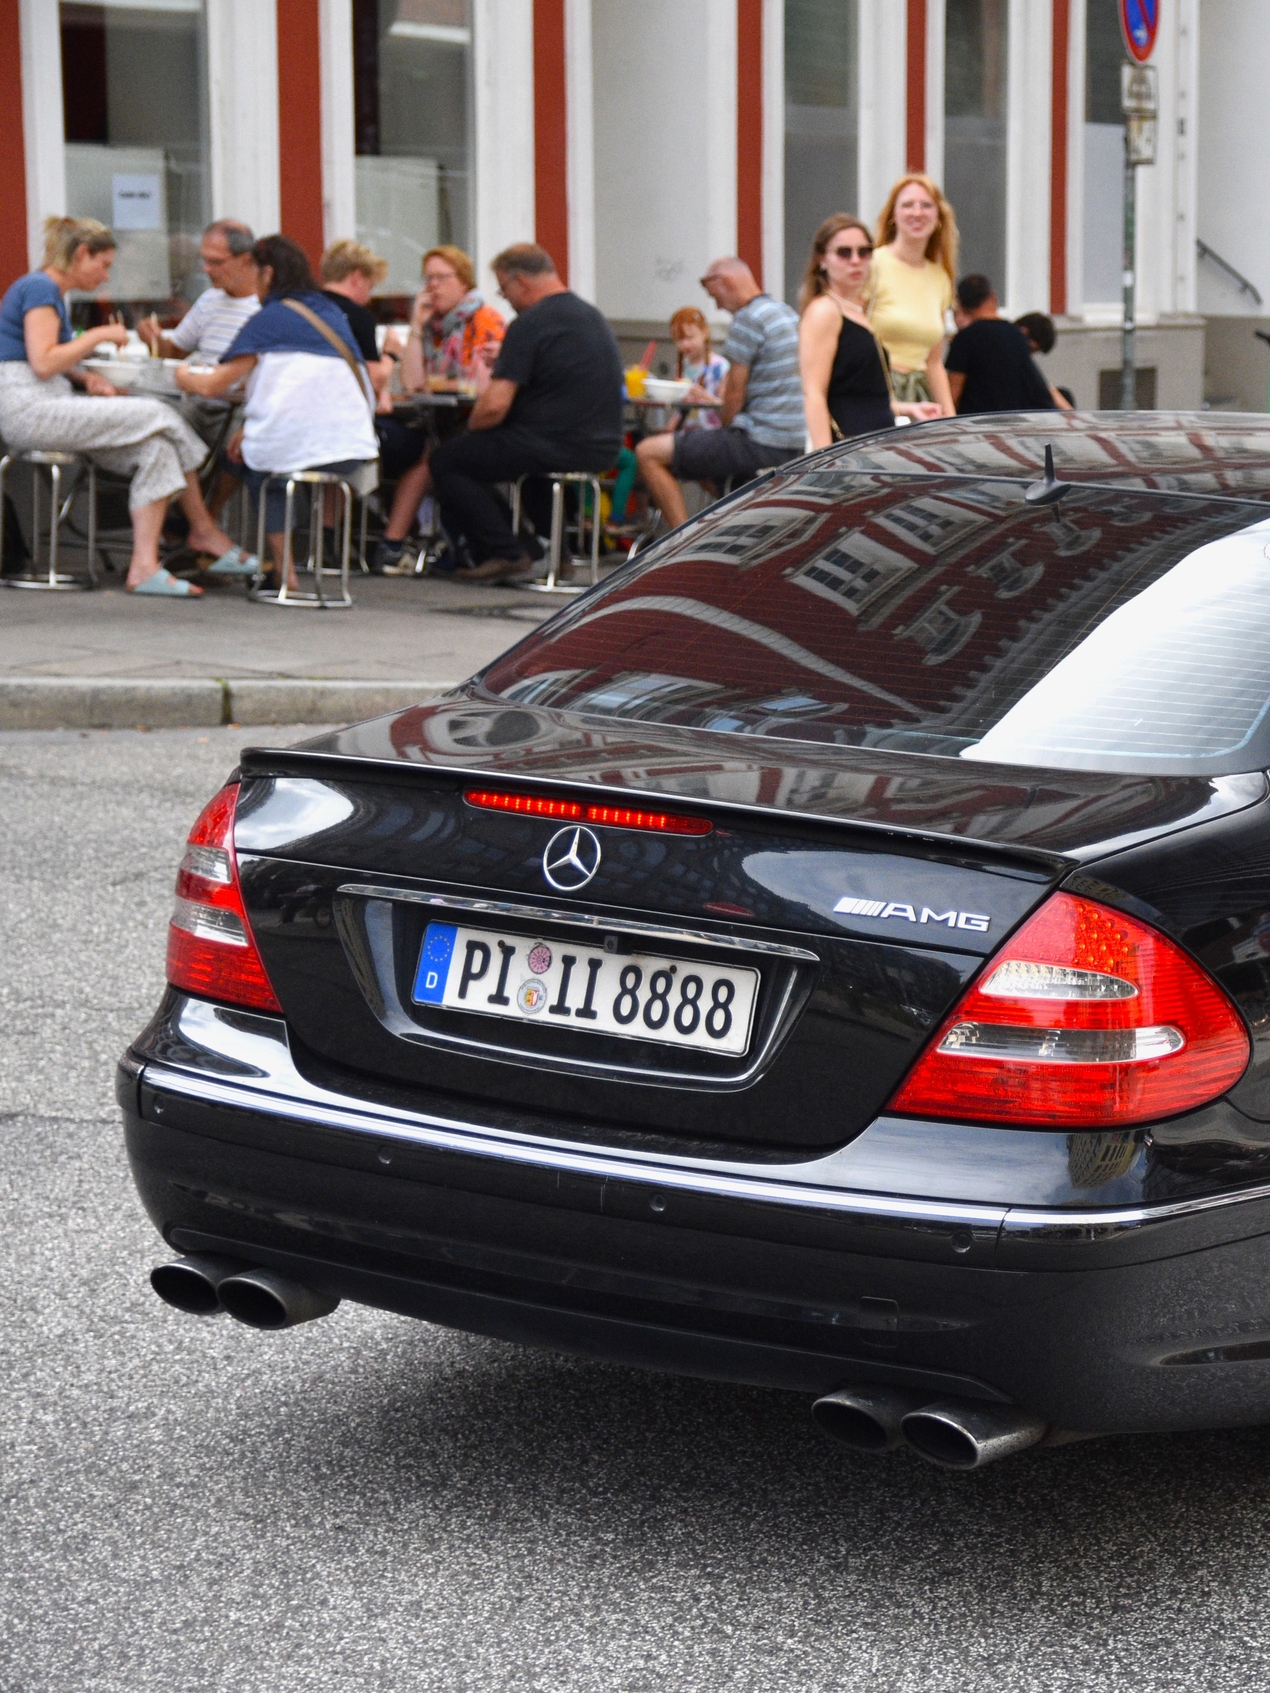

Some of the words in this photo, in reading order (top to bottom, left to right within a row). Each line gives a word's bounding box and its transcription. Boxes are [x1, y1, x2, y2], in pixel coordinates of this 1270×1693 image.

[880, 902, 991, 932] AMG
[425, 971, 439, 989] D
[458, 939, 516, 1006] PI
[548, 954, 603, 1020] II
[612, 965, 736, 1040] 8888
